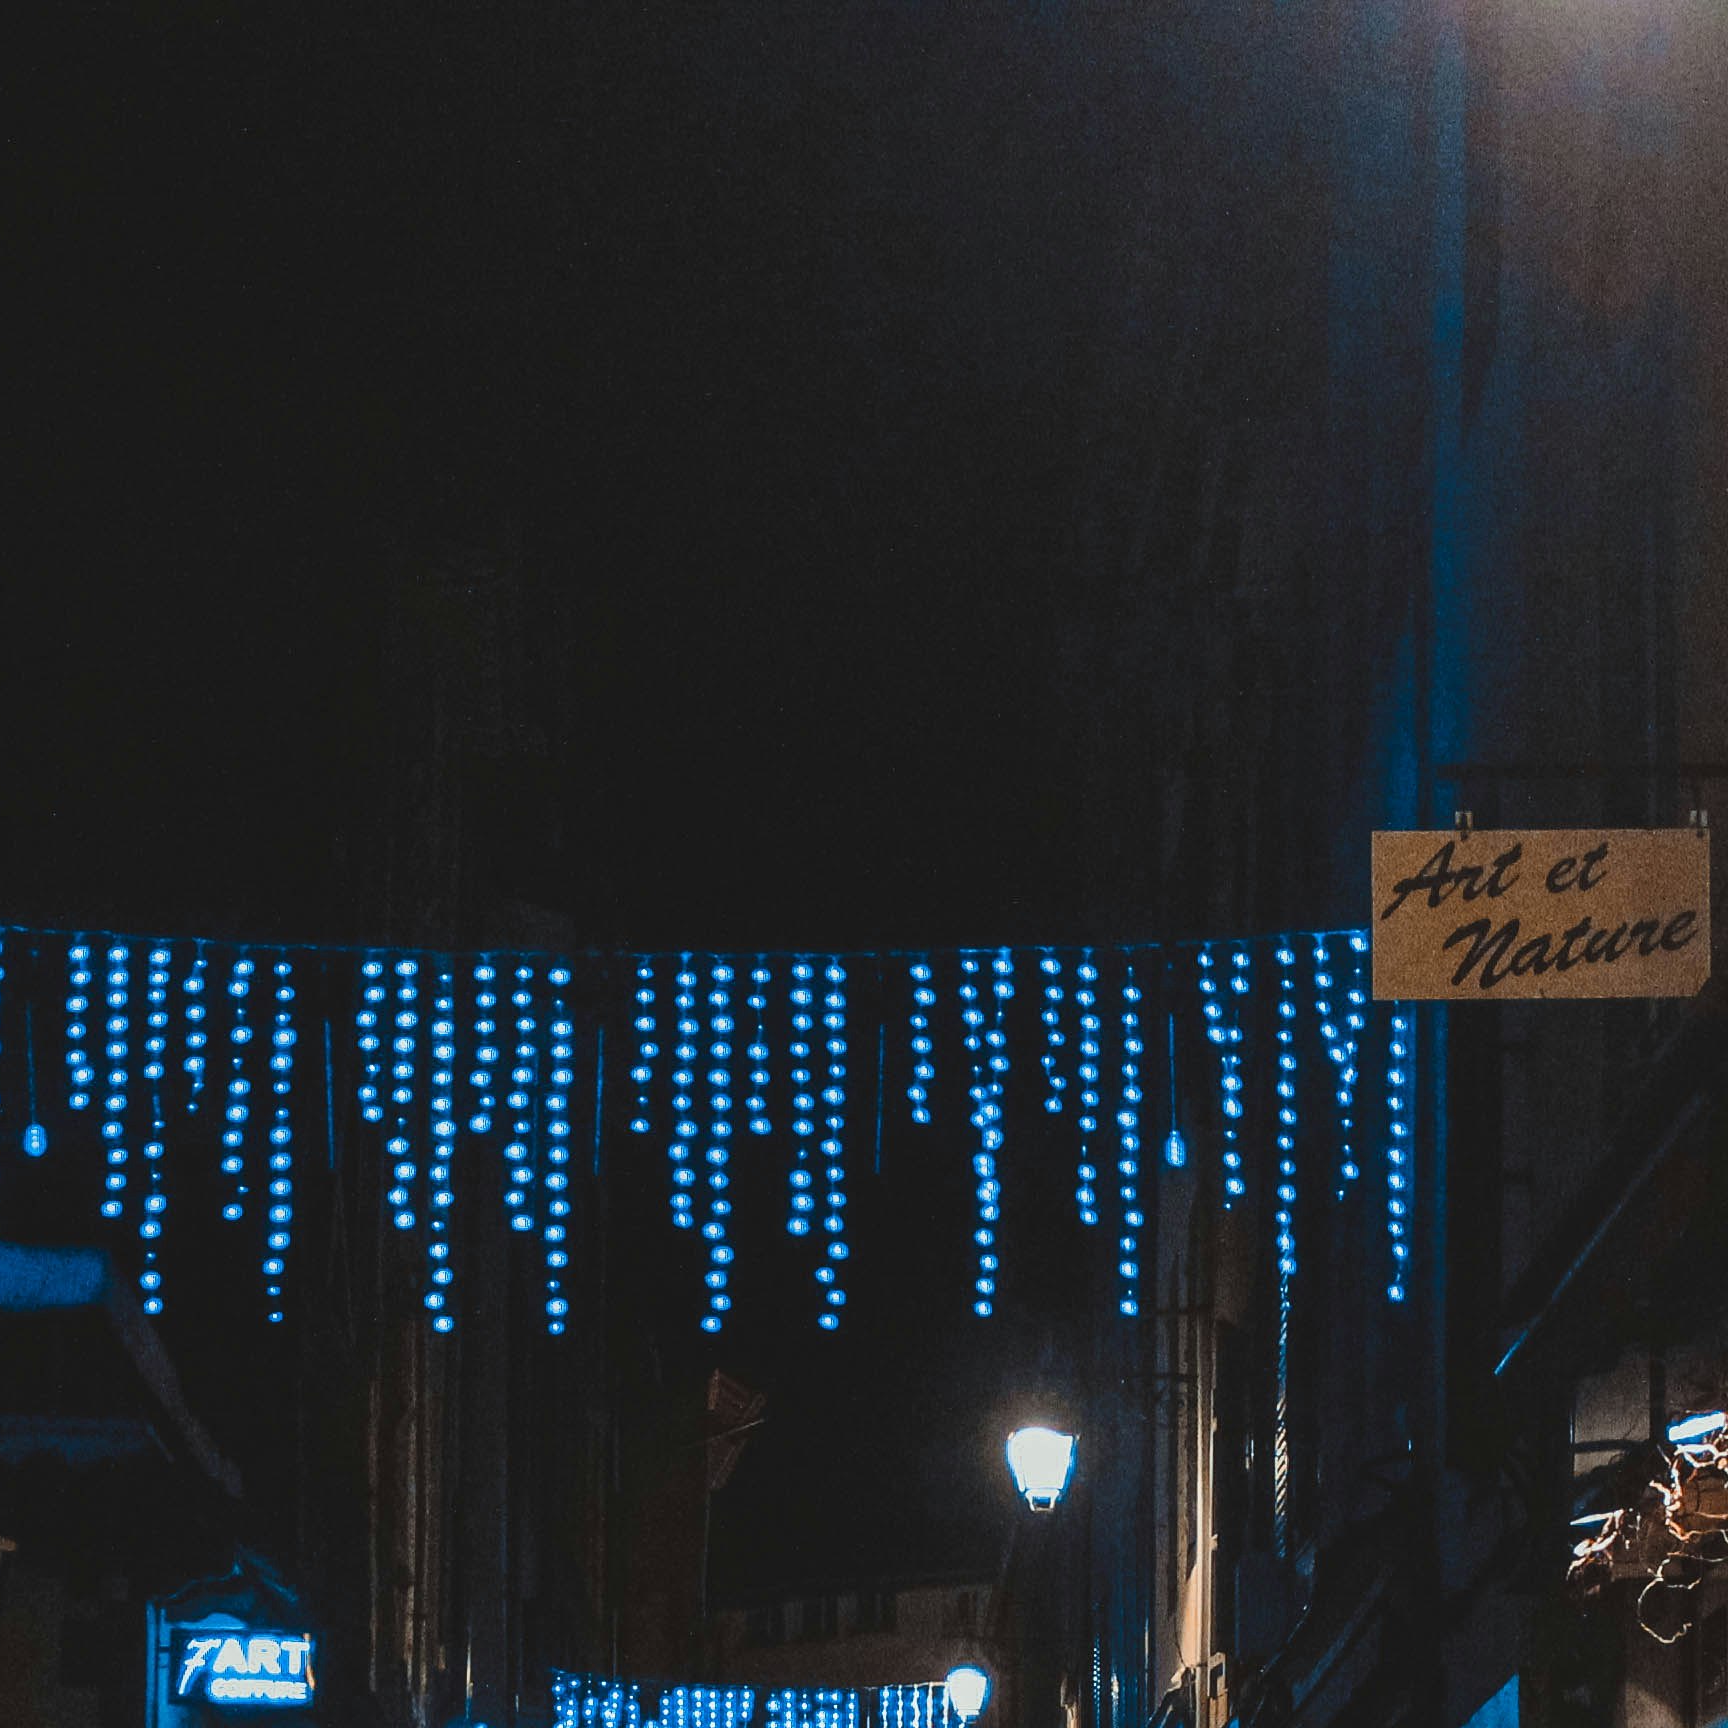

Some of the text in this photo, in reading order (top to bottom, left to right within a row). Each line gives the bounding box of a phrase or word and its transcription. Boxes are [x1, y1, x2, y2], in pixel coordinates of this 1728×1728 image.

[1380, 841, 1608, 920] Art et
[1442, 910, 1698, 990] Nature
